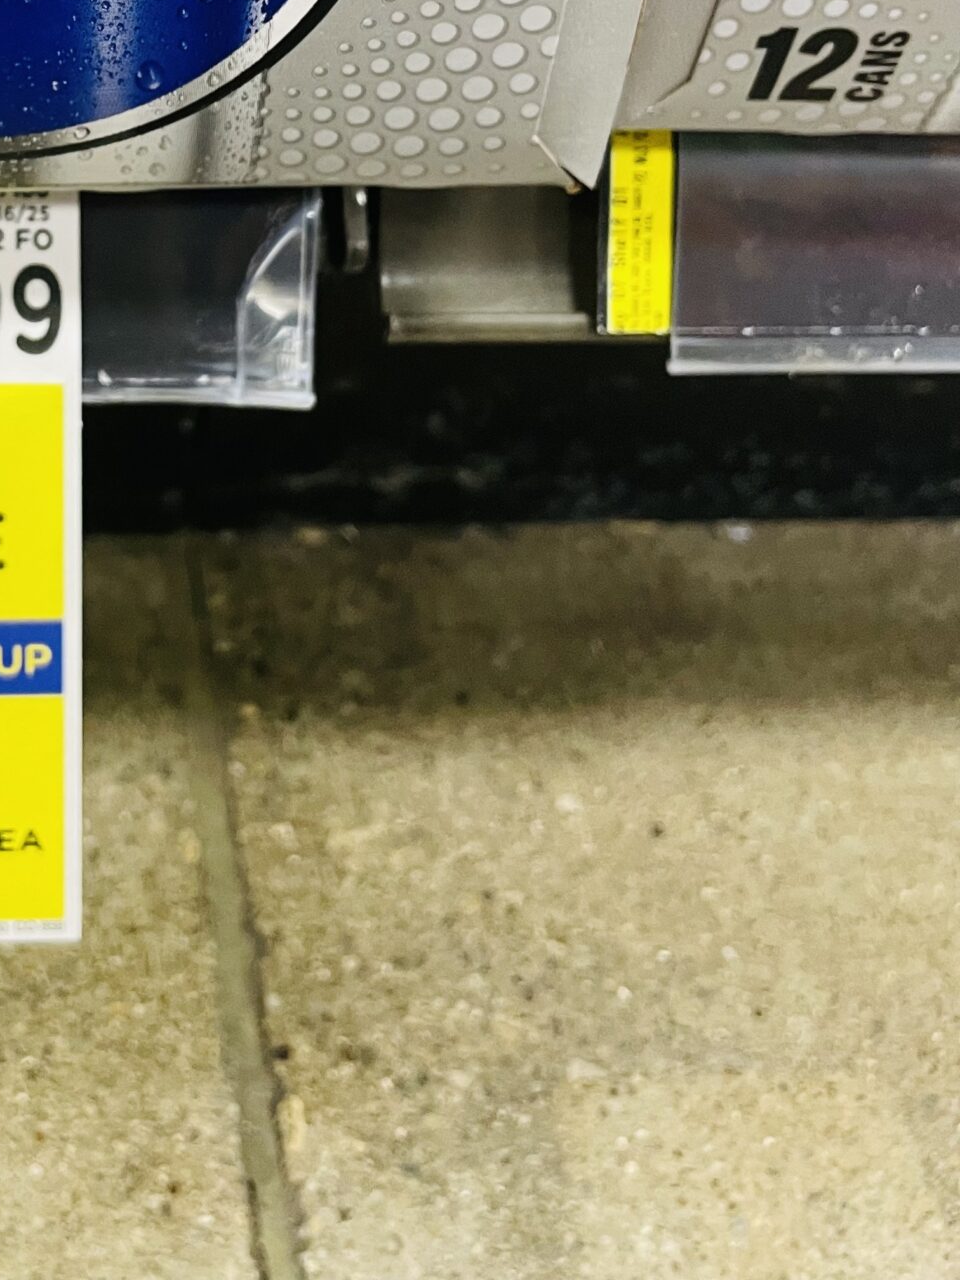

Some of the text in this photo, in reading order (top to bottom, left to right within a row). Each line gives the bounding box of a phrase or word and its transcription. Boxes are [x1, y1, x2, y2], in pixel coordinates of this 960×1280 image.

[746, 27, 910, 103] 12 CANS
[16, 228, 54, 251] FO
